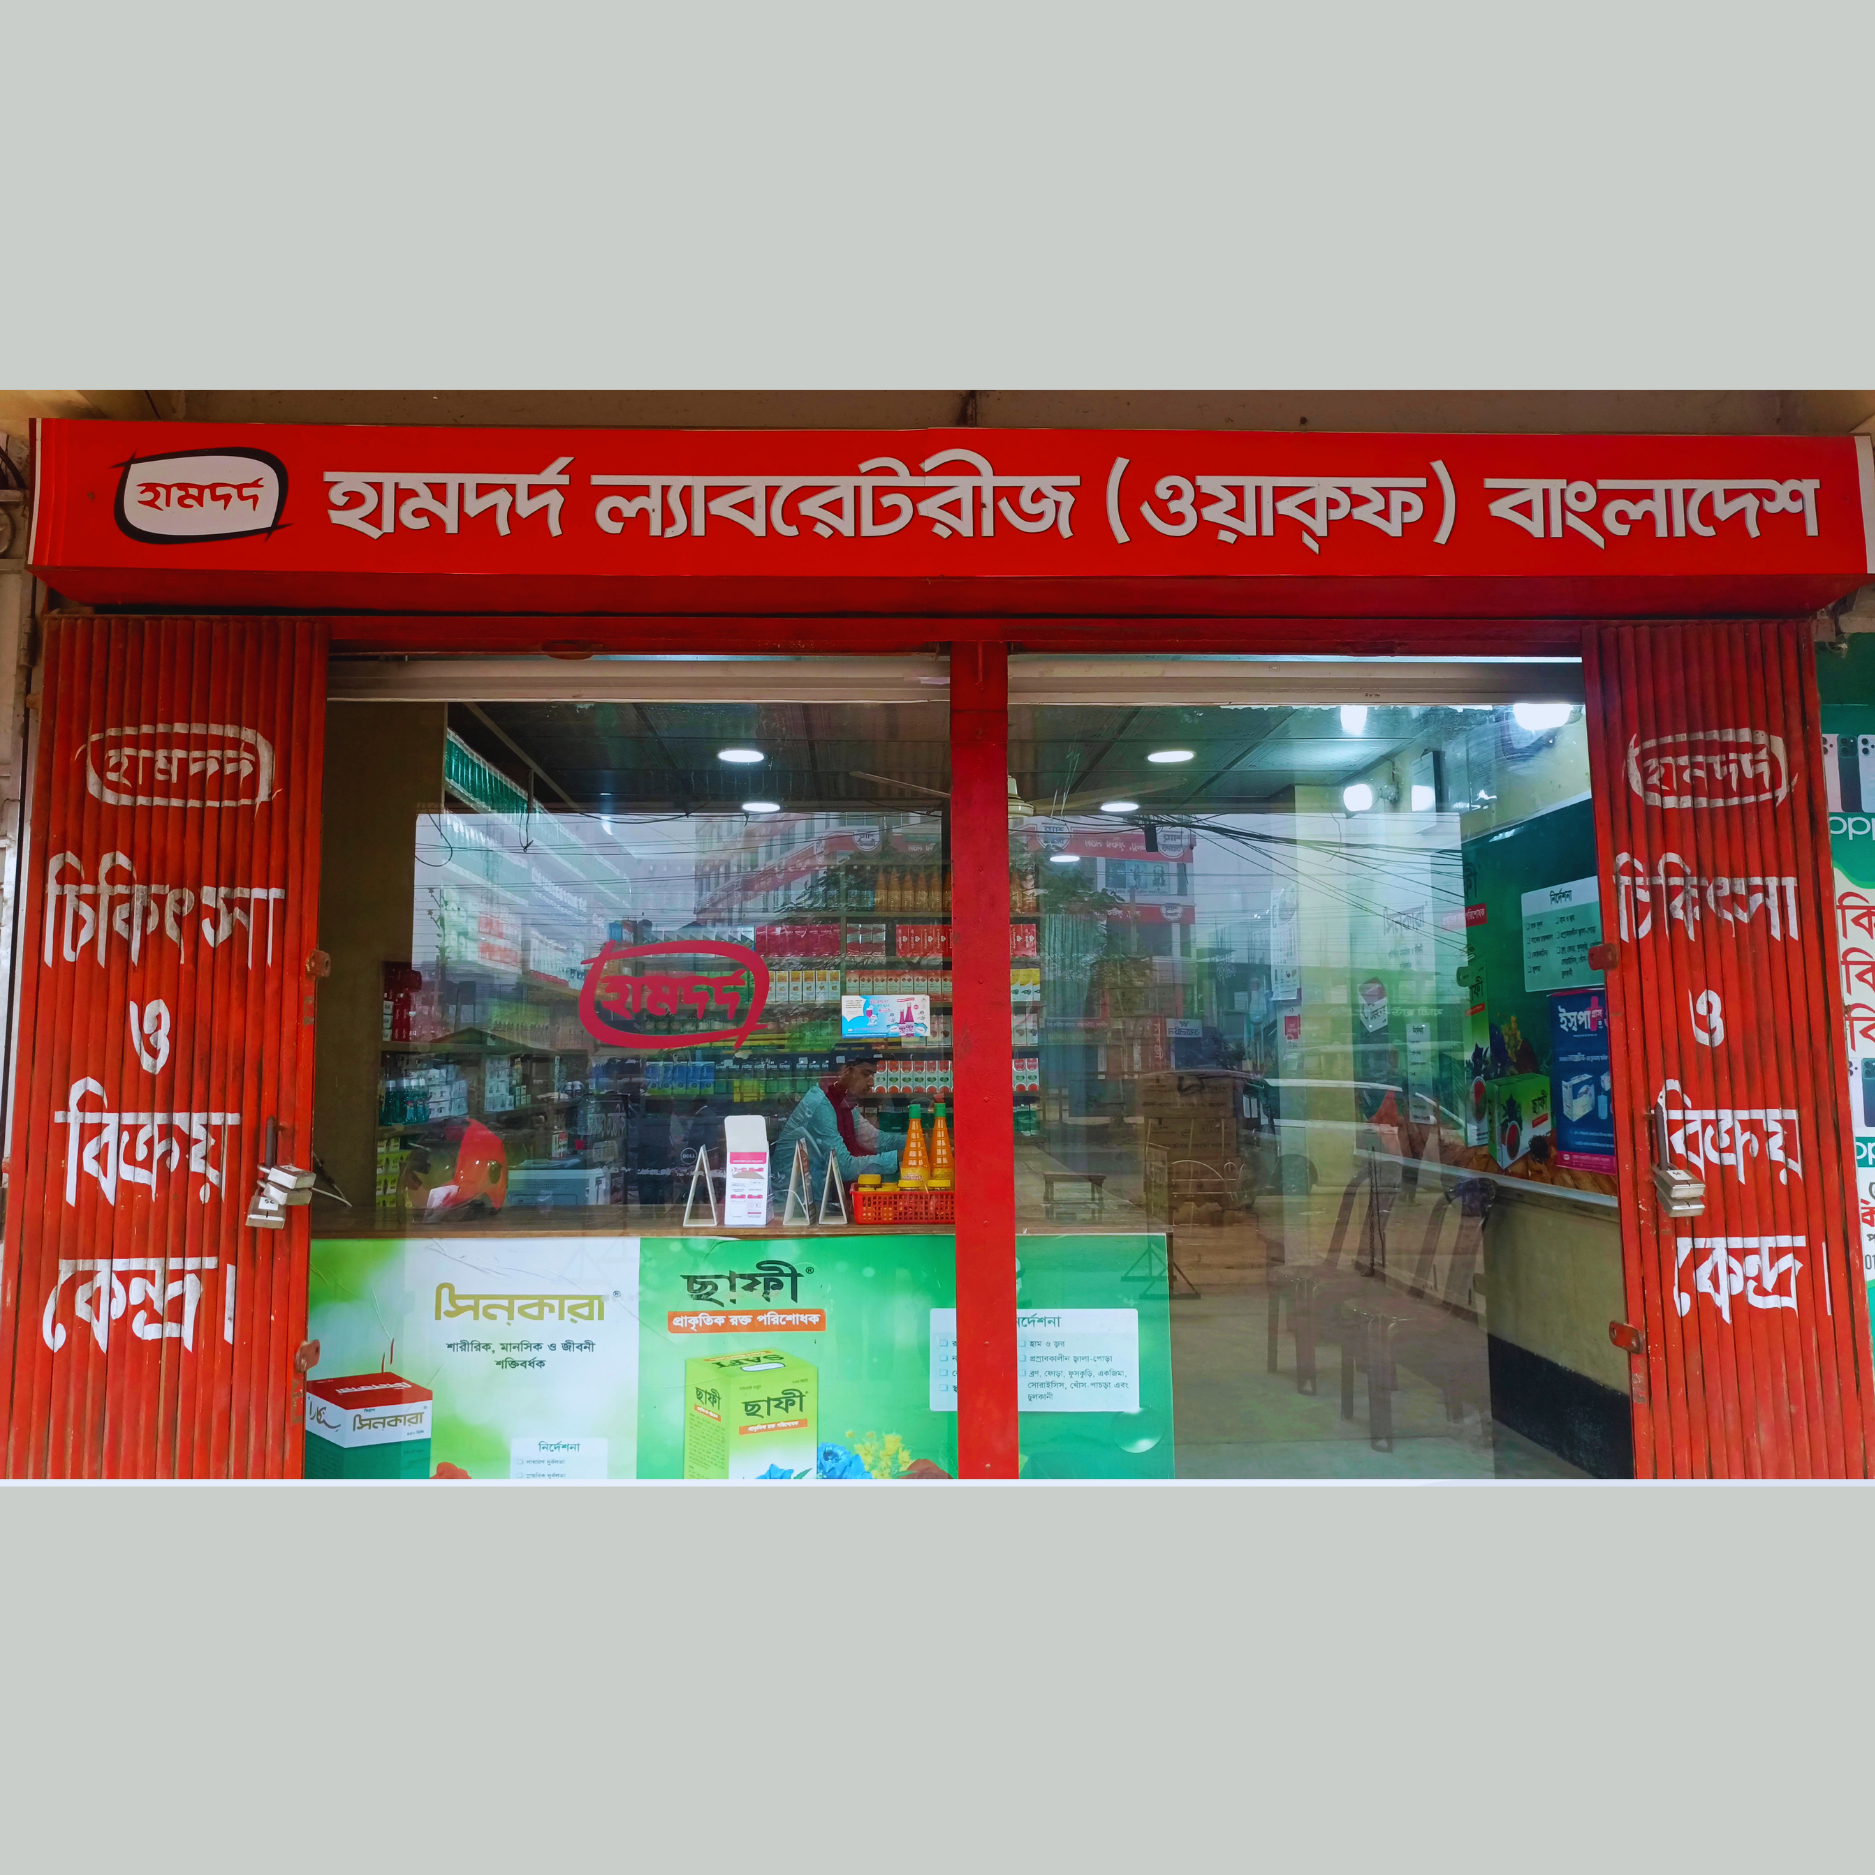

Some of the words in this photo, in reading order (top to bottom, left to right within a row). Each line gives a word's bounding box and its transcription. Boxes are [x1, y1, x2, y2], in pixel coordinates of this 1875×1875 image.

[136, 477, 265, 512] হামদর্দ
[323, 456, 575, 541] হামদর্দ
[591, 449, 1081, 541] ল্যাবরেটরীজ
[1483, 477, 1820, 550] বাংলাদেশ
[44, 850, 286, 971] চিকিৎসা
[1612, 851, 1799, 944] চিকিৎসা
[600, 969, 746, 1020] হামদর্দ
[1689, 989, 1725, 1047] ও
[130, 999, 170, 1075] ও
[54, 1076, 241, 1207] বিক্রয়
[499, 1339, 543, 1353] মানসিক
[547, 1343, 557, 1353] ও
[561, 1339, 595, 1353] জীবনী
[672, 1312, 727, 1332] প্রাকৃতিক
[728, 1315, 753, 1326] রক্ত
[756, 1311, 821, 1326] পরিশোধক
[494, 1356, 546, 1370] শক্তিবর্ধক
[741, 1388, 806, 1419] ছাফী
[538, 1440, 581, 1453] নির্দেশনা
